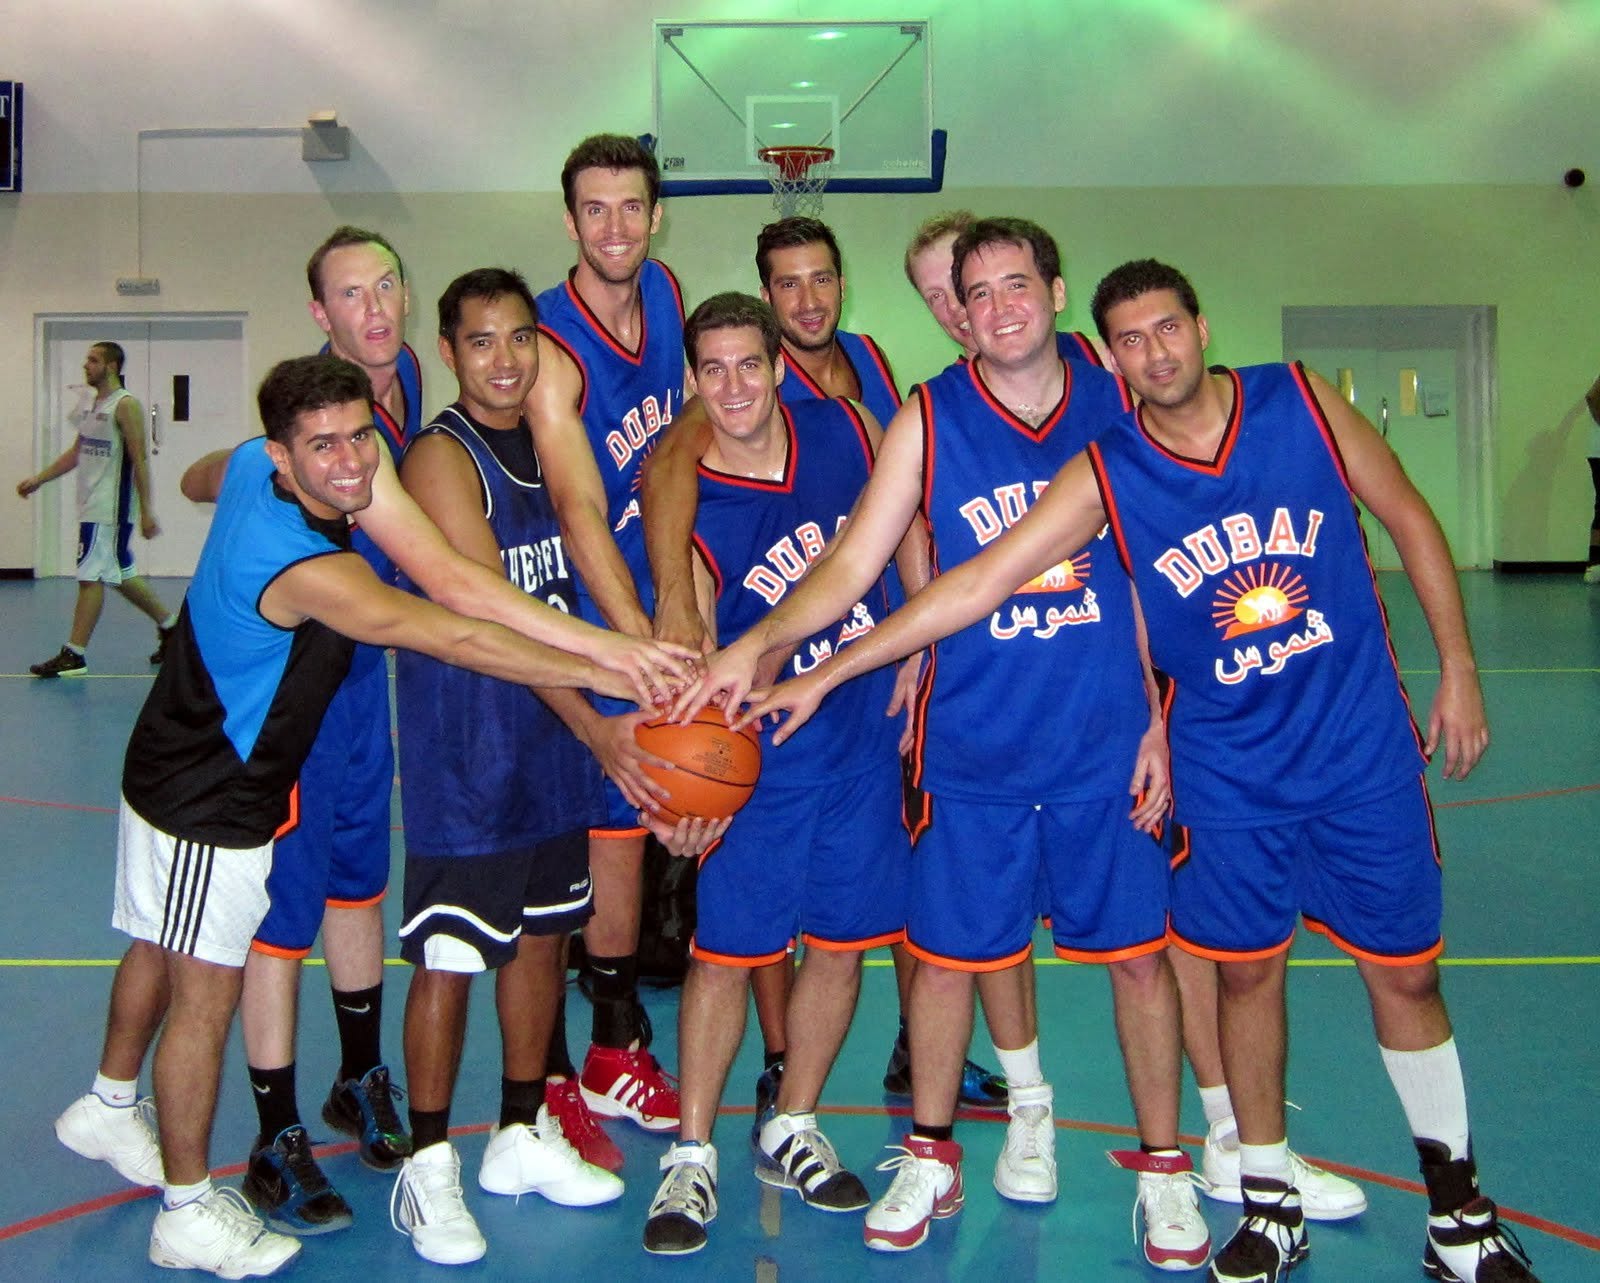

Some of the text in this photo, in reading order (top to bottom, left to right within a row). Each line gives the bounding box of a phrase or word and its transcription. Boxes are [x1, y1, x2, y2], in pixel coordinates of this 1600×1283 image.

[606, 388, 679, 472] DUBA
[743, 515, 848, 606] DUB
[1153, 507, 1325, 599] DUBAI
[990, 587, 1101, 640] شموس
[1214, 609, 1335, 686] شموس
